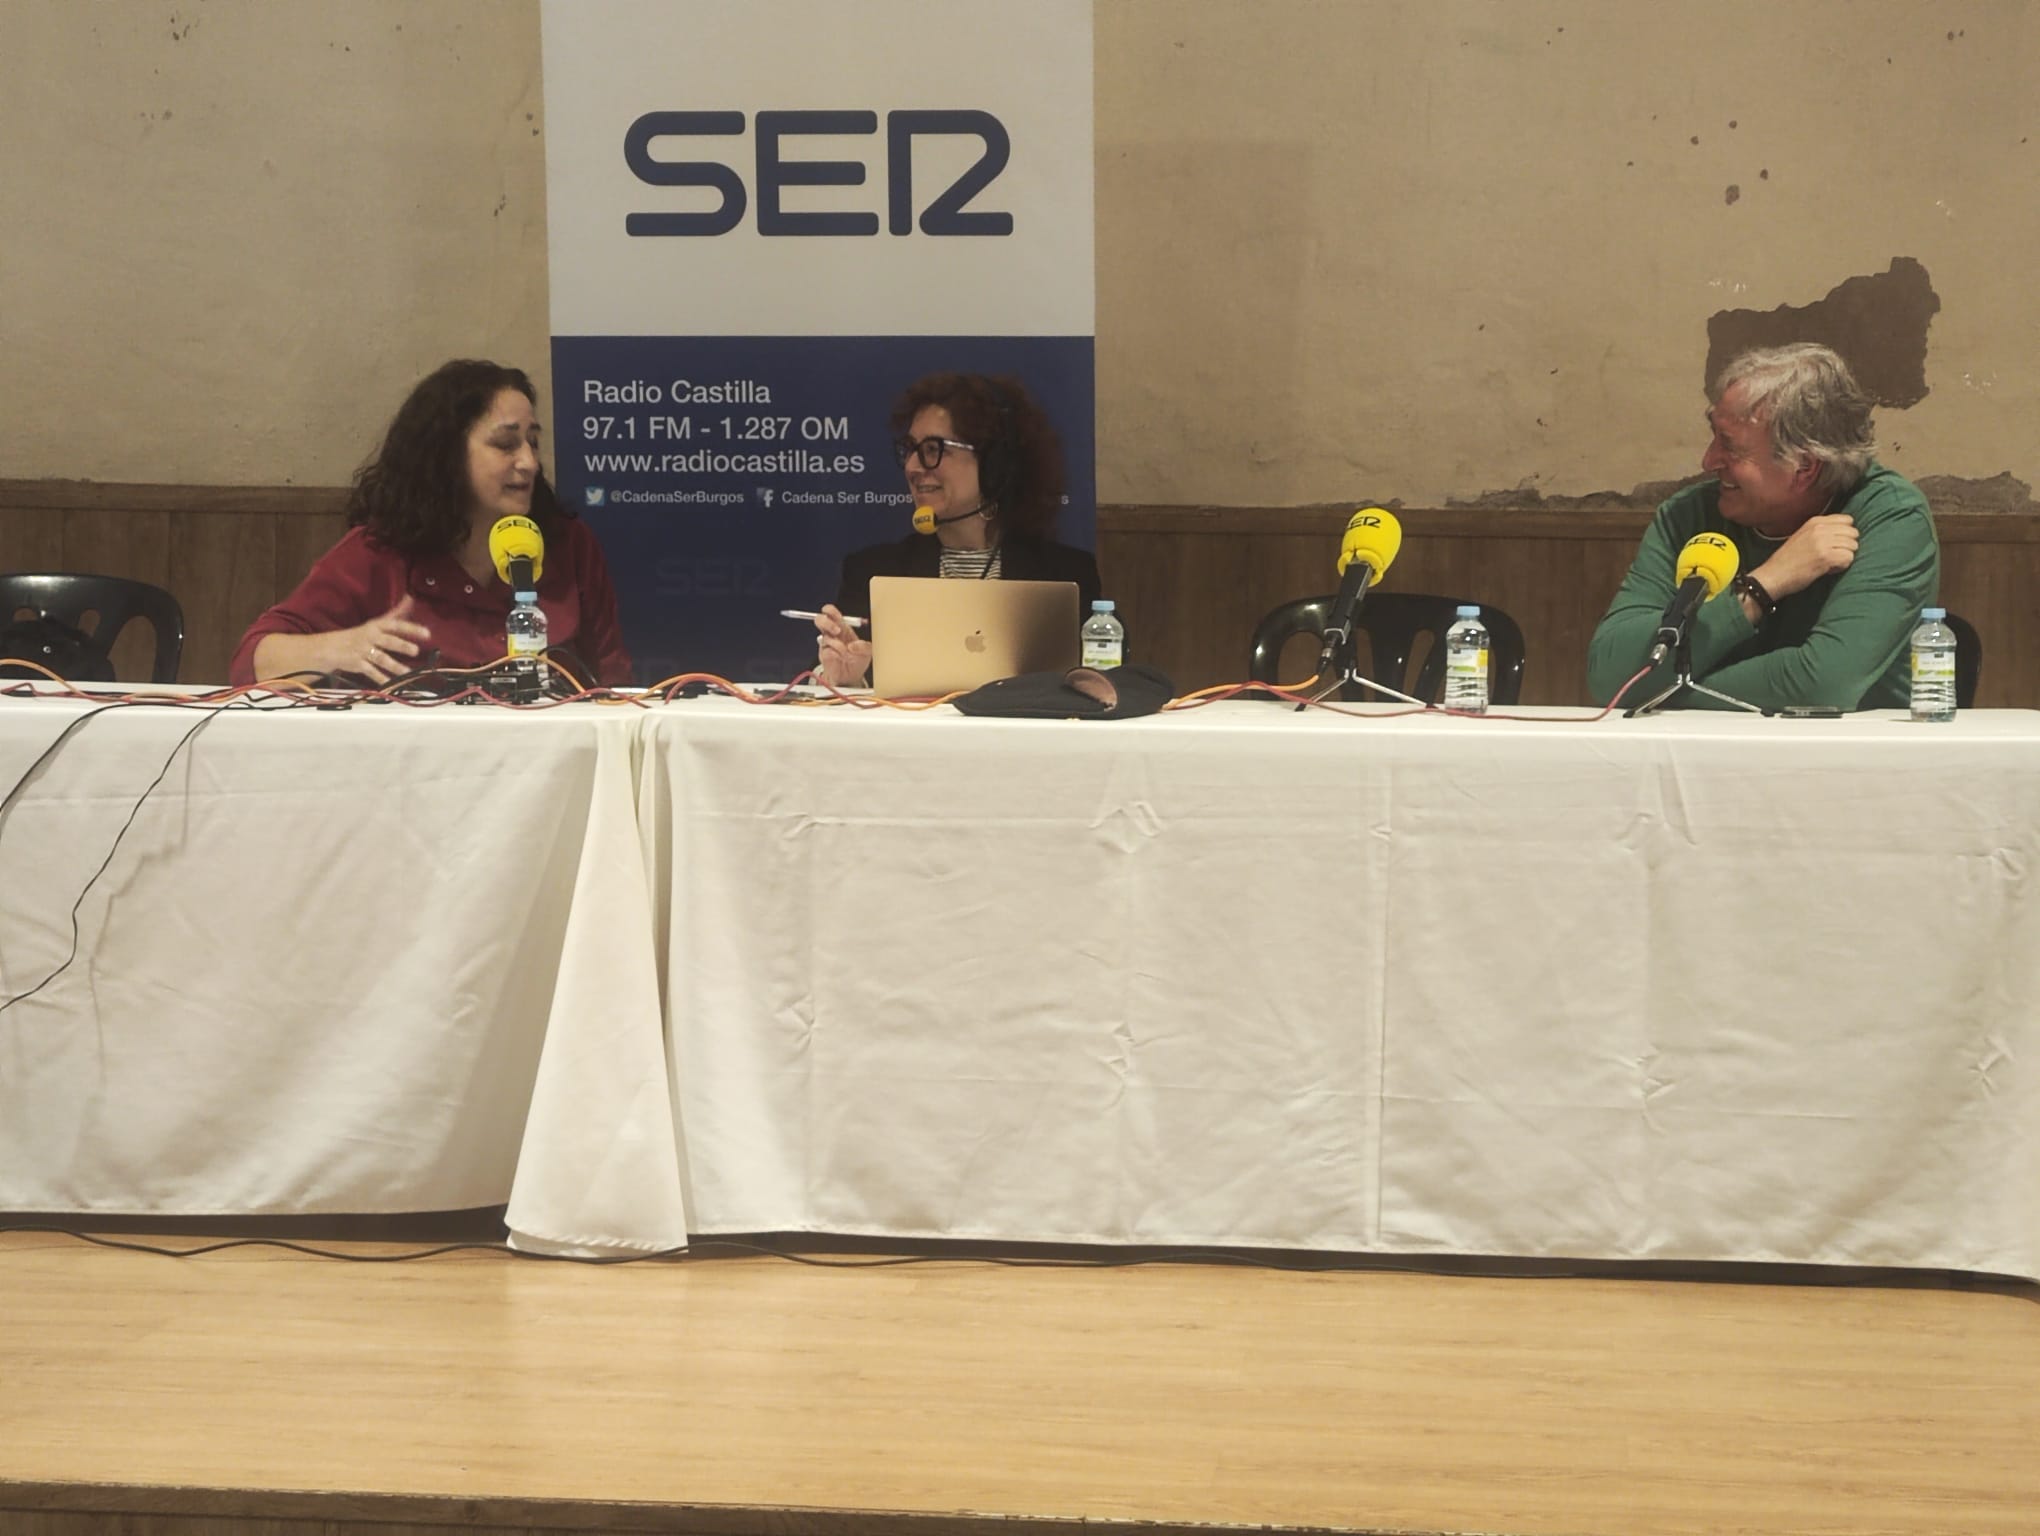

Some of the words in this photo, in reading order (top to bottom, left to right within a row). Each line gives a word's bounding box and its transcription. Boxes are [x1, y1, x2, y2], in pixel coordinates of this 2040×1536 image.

[624, 109, 1014, 237] SER
[583, 379, 663, 404] Radio
[670, 379, 772, 404] Castilla
[582, 415, 636, 440] 97.1
[649, 416, 691, 440] FM
[700, 426, 711, 434] -
[720, 416, 792, 441] 1.287
[800, 415, 849, 441] OM
[584, 448, 866, 474] www.radiocastilla.es
[610, 488, 745, 507] @CadenaSerBurgos
[781, 490, 834, 505] Cadena
[837, 490, 861, 505] Ser
[864, 490, 913, 508] Burgos
